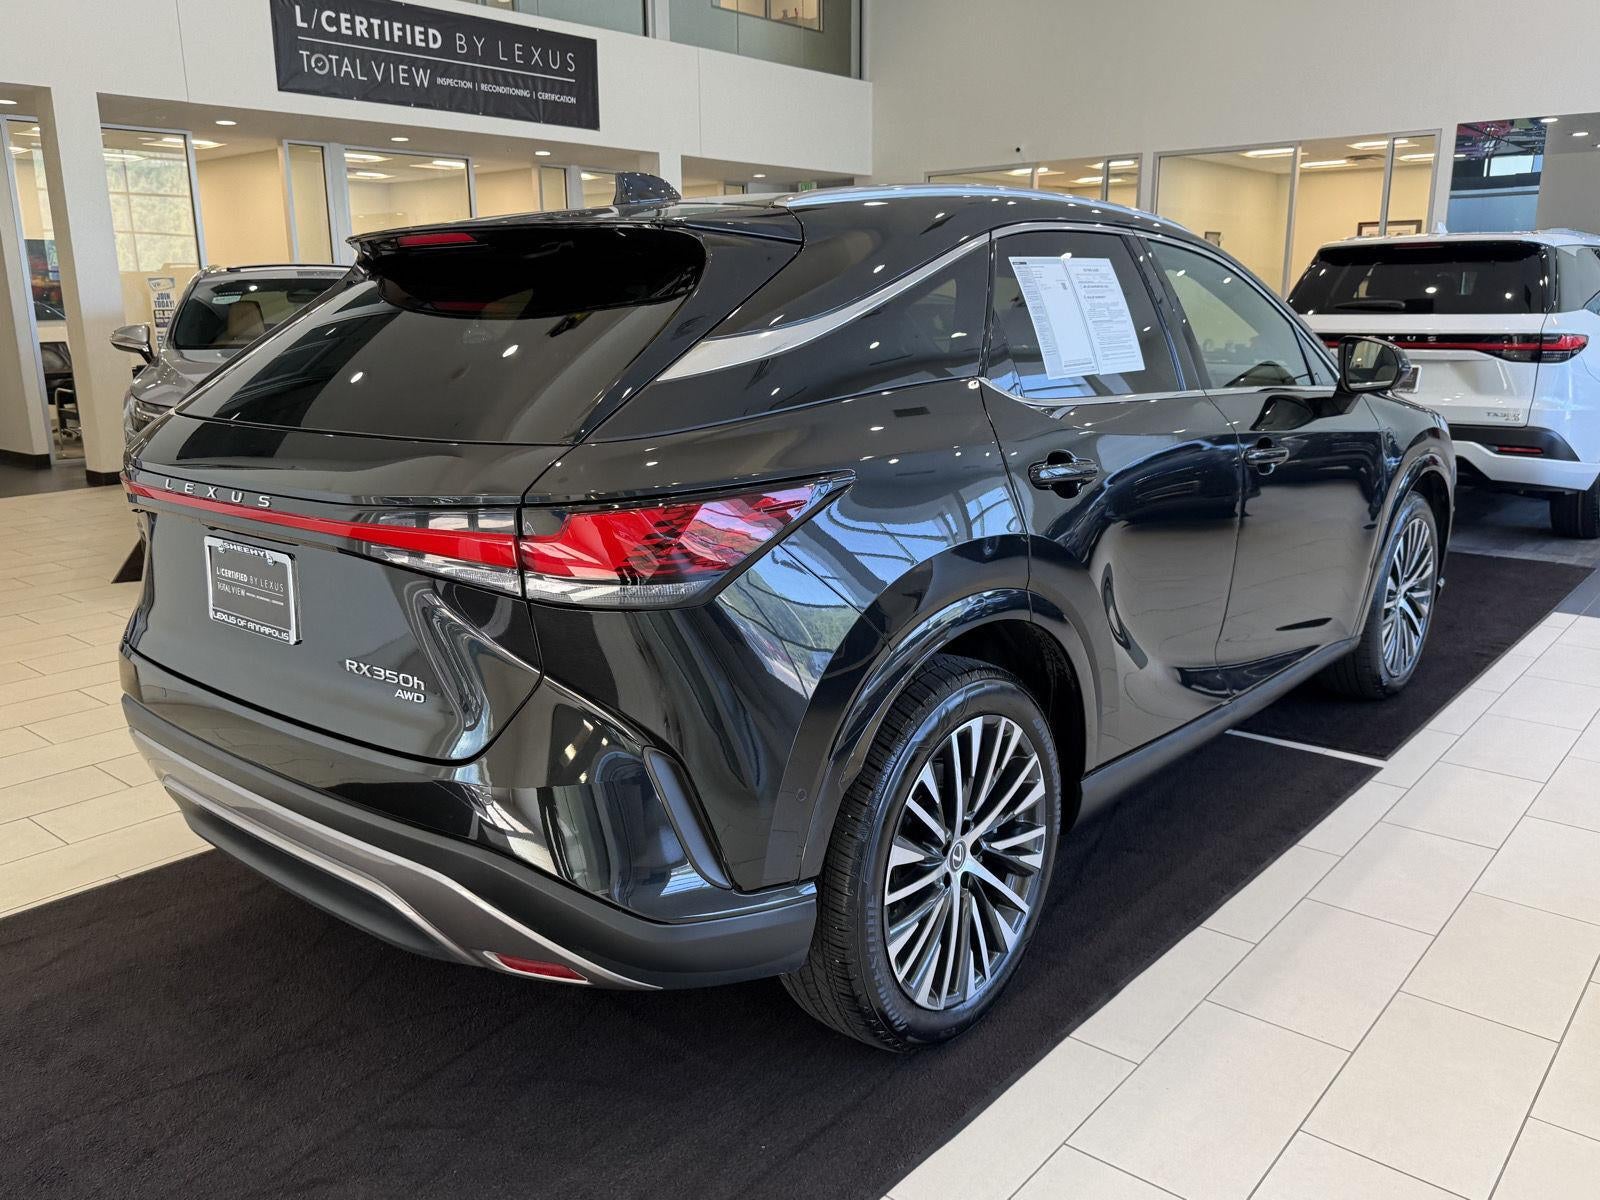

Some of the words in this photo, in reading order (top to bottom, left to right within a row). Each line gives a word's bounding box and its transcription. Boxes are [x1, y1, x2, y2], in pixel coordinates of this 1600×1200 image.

[295, 4, 443, 50] L/CERTIFIED
[456, 33, 485, 57] BY
[499, 40, 576, 73] LEXUS
[437, 77, 473, 89] INSPECTION
[480, 83, 531, 98] RECONDITIONING
[537, 91, 577, 104] CERTIFICATION
[165, 478, 270, 508] LEXUS
[223, 542, 266, 558] SHEEHY
[249, 575, 258, 586] BY
[260, 579, 284, 593] LEXUS
[212, 610, 236, 625] LEXUS
[237, 618, 247, 628] OF
[247, 621, 289, 641] ANNAPOLIS
[345, 659, 425, 691] RX350h
[394, 689, 425, 703] AWD
